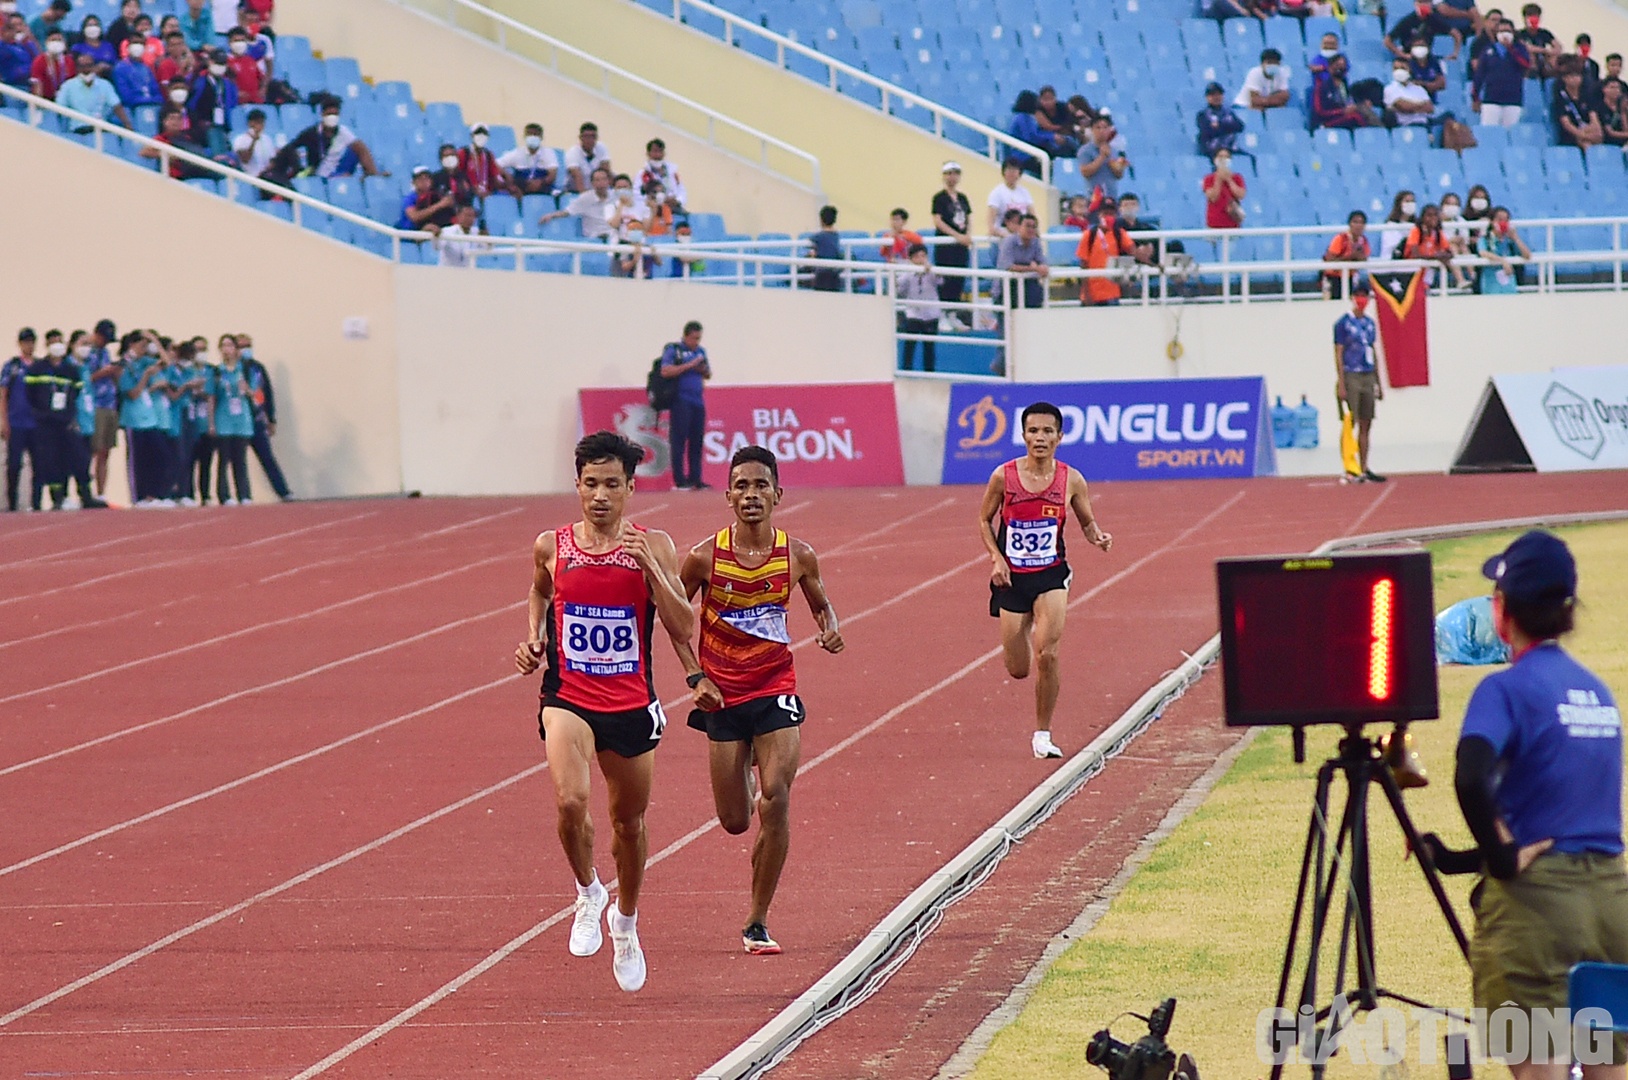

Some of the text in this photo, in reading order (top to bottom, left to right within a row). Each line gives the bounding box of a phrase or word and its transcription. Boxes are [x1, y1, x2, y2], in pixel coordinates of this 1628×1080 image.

[752, 408, 800, 429] BIA
[703, 428, 854, 464] SAIGON
[1137, 449, 1244, 469] SPORT.VN
[1011, 531, 1052, 553] 832
[588, 606, 602, 618] SEA
[602, 608, 626, 618] Games
[569, 623, 633, 654] 808
[1369, 578, 1393, 700] 1
